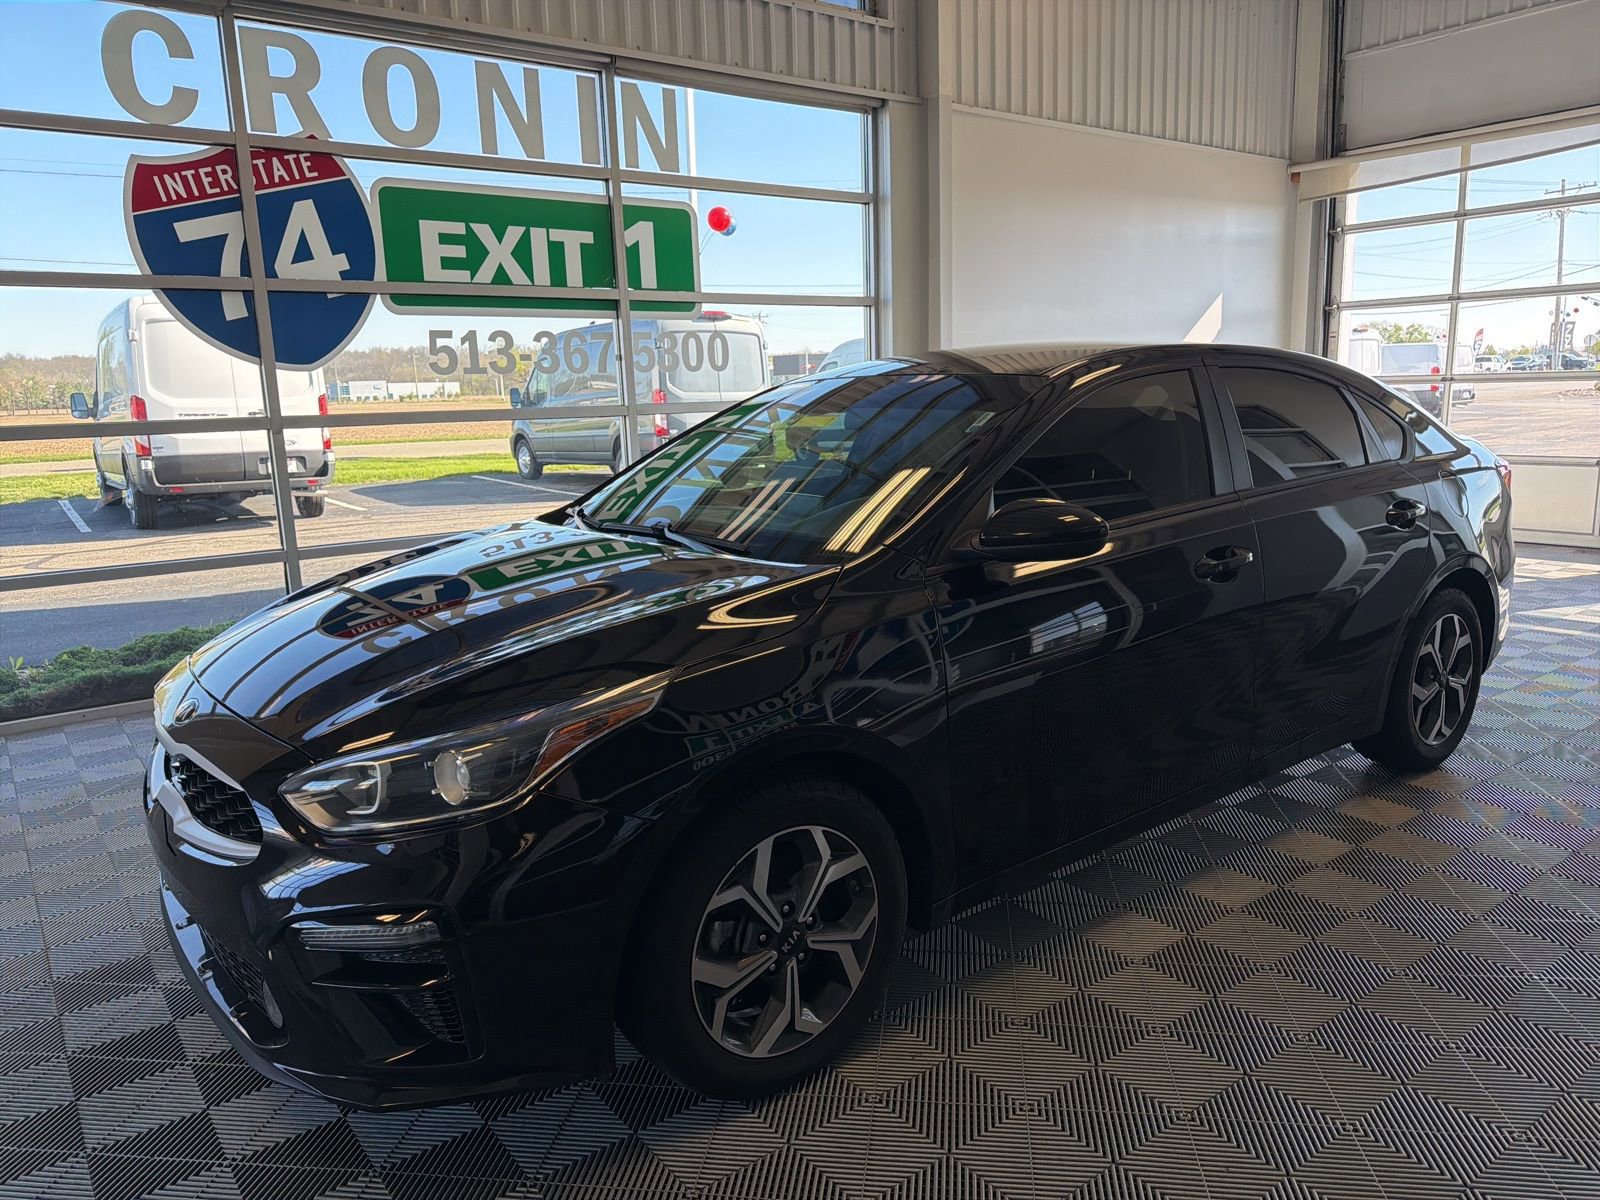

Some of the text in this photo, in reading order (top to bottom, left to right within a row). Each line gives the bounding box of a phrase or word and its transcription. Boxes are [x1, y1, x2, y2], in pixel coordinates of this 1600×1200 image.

[101, 10, 680, 174] CRONIN
[153, 153, 319, 202] INTERTATE
[173, 199, 350, 321] 74
[418, 219, 658, 289] EXIT 1
[781, 929, 801, 954] KIA
